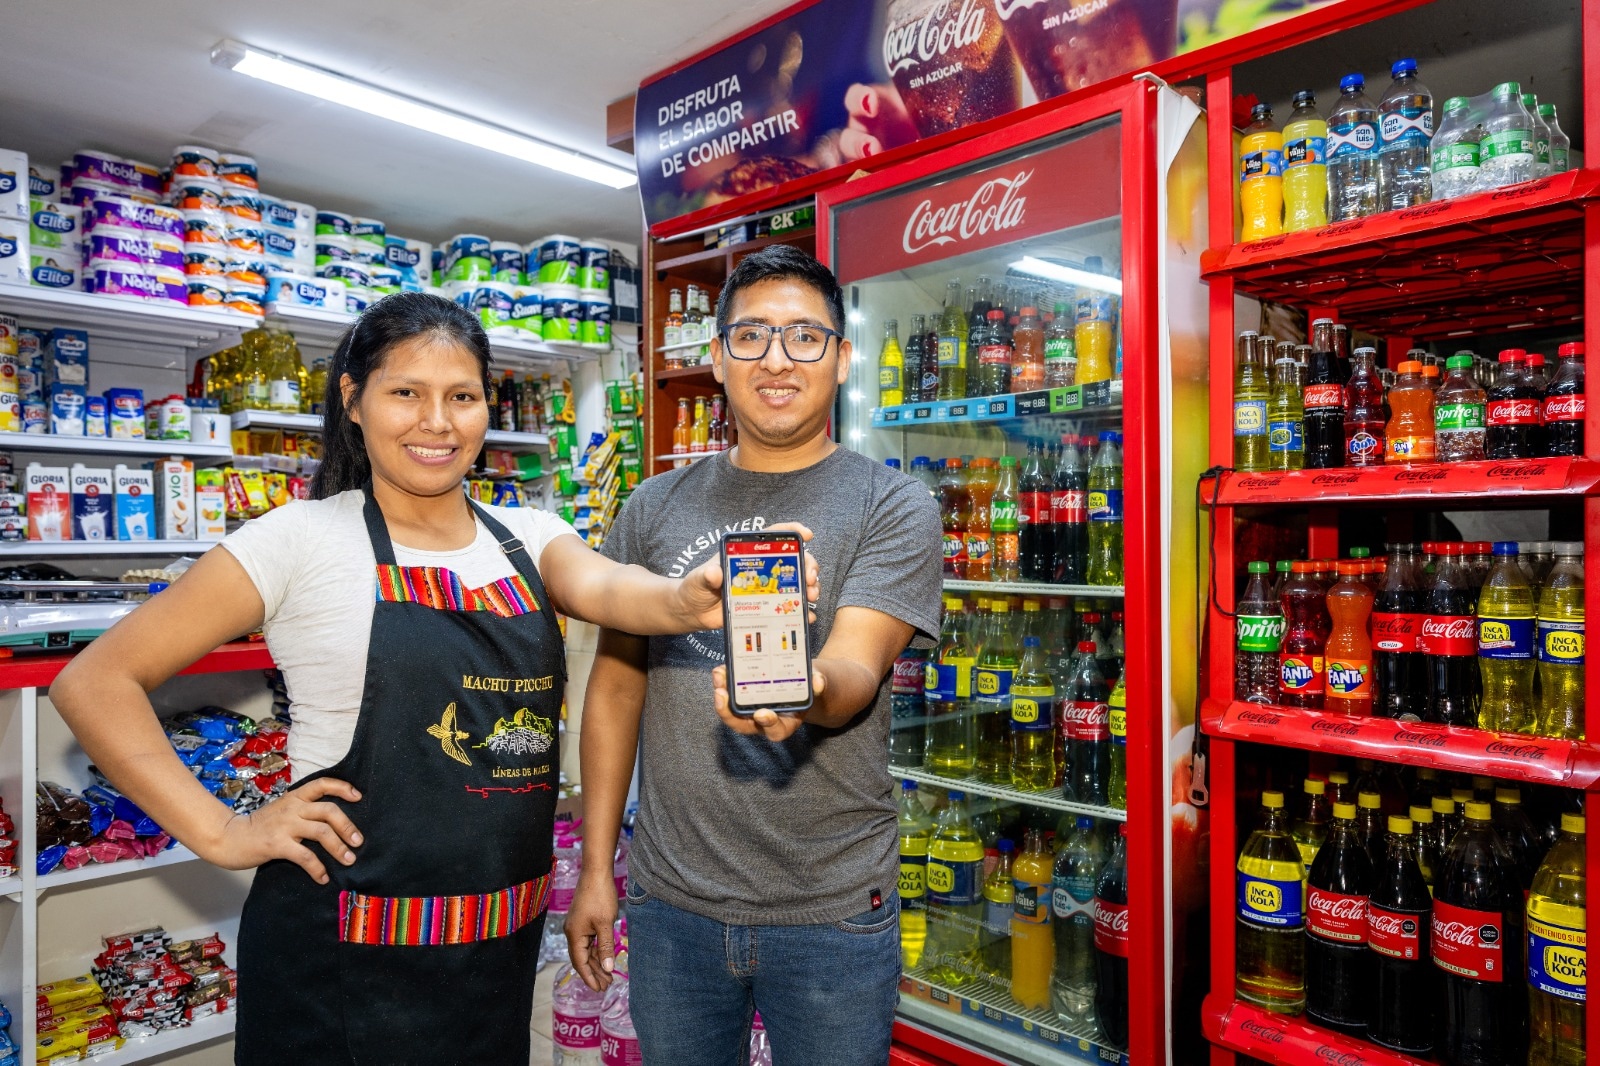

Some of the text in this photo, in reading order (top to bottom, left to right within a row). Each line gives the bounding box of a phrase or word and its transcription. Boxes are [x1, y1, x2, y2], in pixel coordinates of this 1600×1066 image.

[1042, 16, 1060, 30] SIN
[883, 0, 985, 77] Coca-Cola
[909, 61, 963, 89] SIN AZÚCAR
[658, 74, 741, 127] DISFRUTA
[659, 101, 743, 150] EL SABOR
[1383, 116, 1398, 128] san
[1355, 128, 1371, 136] san
[1355, 134, 1370, 142] luis
[1384, 126, 1398, 135] luis
[661, 109, 800, 178] DE COMPARTIR
[102, 161, 143, 180] Noble
[29, 180, 51, 193] lite
[271, 206, 296, 220] Elite
[902, 167, 1034, 254] Coca-Cola
[38, 213, 72, 230] Elite
[118, 239, 162, 259] Noble
[269, 235, 294, 249] Elite
[389, 247, 418, 264] Elite
[38, 269, 71, 285] Elite
[121, 271, 165, 292] Noble
[300, 283, 326, 300] Elite
[512, 303, 543, 318] Suave
[1304, 390, 1340, 405] Coca-Cola
[1436, 407, 1472, 421] Sprite
[1492, 403, 1534, 418] Coca-Cola
[1547, 399, 1586, 414] Coca-Cola
[1238, 418, 1259, 426] KOLA
[1311, 472, 1363, 485] Coca-Cola
[1394, 468, 1451, 483] Coca-Cola
[1486, 464, 1550, 478] Coca-Cola
[31, 475, 65, 485] GLORIA
[75, 476, 109, 486] GLORIA
[119, 477, 150, 487] GLORIA
[667, 516, 766, 579] UIKSILVER
[943, 539, 964, 552] ANTA
[1237, 618, 1281, 640] Sprite
[1422, 618, 1474, 639] Coca-Cola
[1484, 626, 1503, 634] INCA
[1483, 633, 1504, 641] KOLA
[1553, 636, 1578, 645] INCA
[1551, 644, 1579, 653] KOLA
[1281, 666, 1314, 680] FANTA
[1328, 669, 1364, 684] FANTA
[462, 674, 554, 693] MACHU PICCHU
[1015, 704, 1033, 712] INCA
[1238, 710, 1284, 725] Coca-Cola
[1311, 719, 1362, 736] Coca-Cola
[1394, 730, 1450, 747] Coca-Cola
[1486, 741, 1549, 760] Coca-Cola
[492, 766, 521, 778] LÍNEAS
[522, 768, 532, 776] DE
[929, 867, 948, 879] INCA
[928, 877, 948, 888] KOLA
[1251, 886, 1274, 899] INCA
[1250, 895, 1276, 908] KOLA
[1309, 891, 1367, 920] Coca-Cola
[1095, 902, 1128, 932] Coca-Co
[1534, 925, 1567, 940] CONTENIDO
[1553, 951, 1586, 967] INCA
[1552, 963, 1586, 978] KOLA
[165, 979, 180, 988] FIELD
[1241, 1020, 1285, 1044] Coca-Cola
